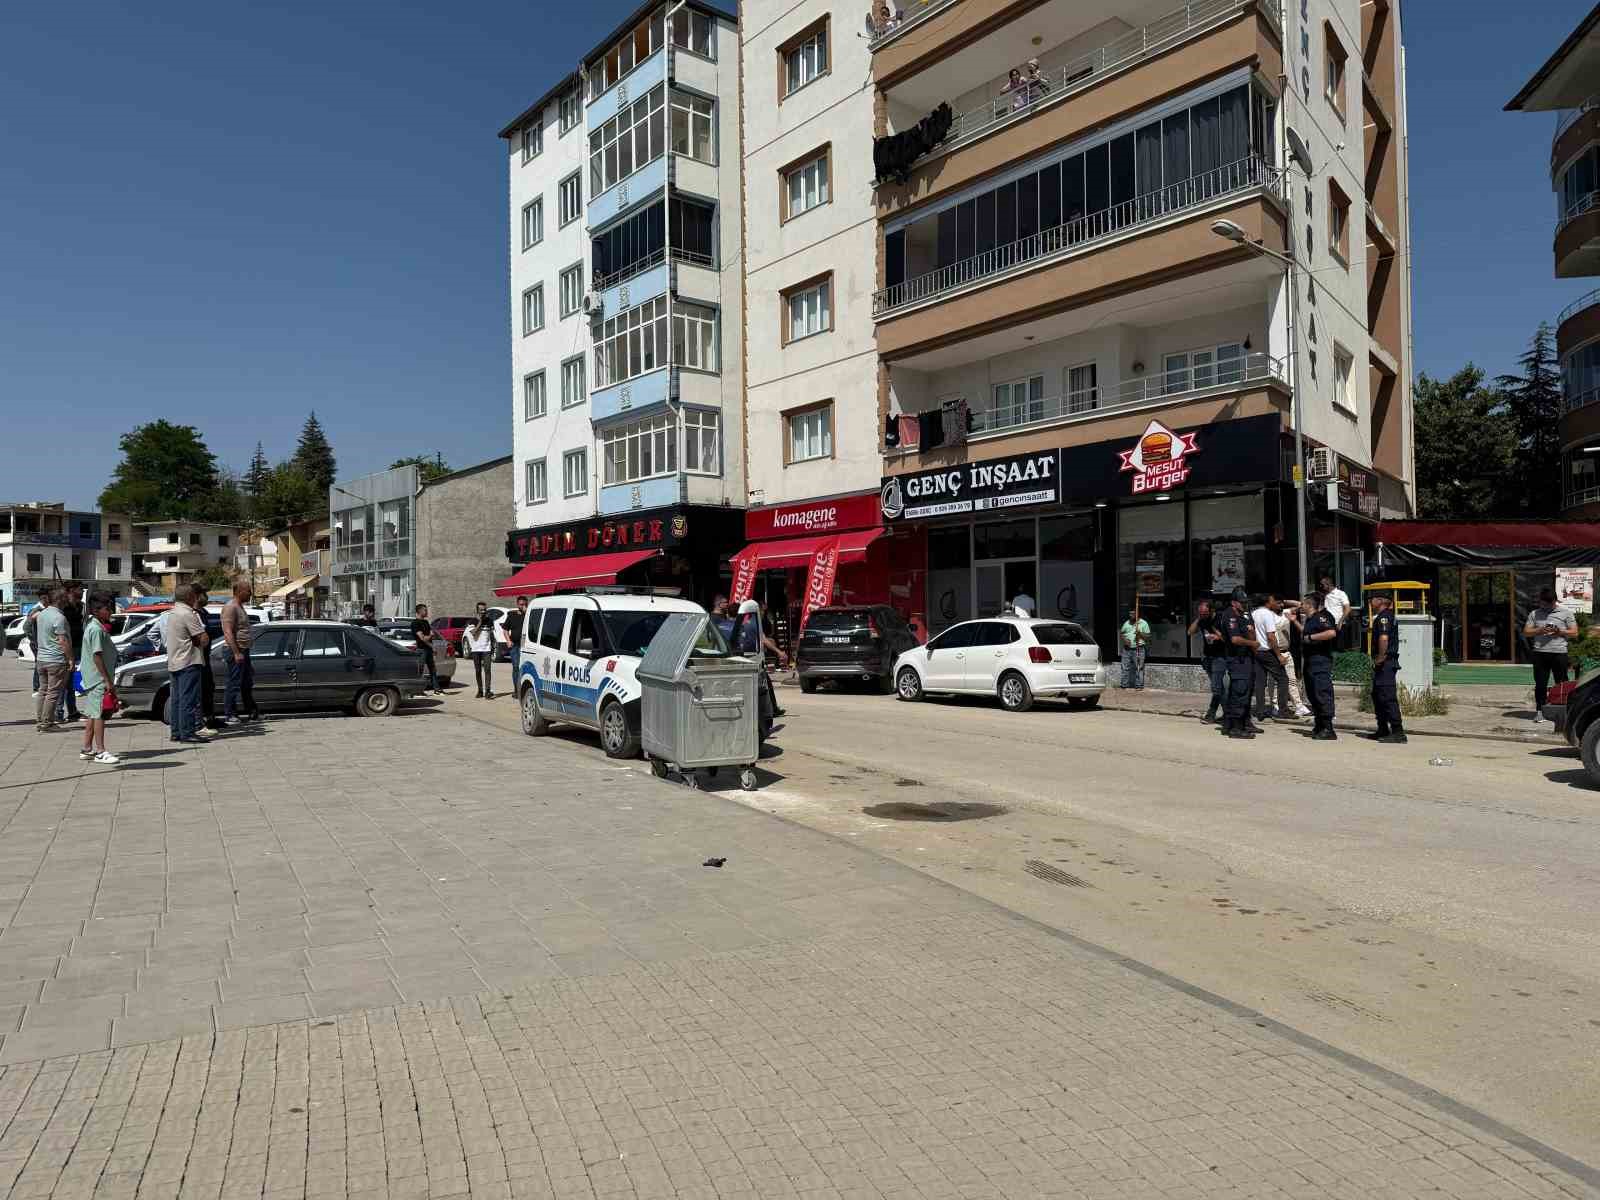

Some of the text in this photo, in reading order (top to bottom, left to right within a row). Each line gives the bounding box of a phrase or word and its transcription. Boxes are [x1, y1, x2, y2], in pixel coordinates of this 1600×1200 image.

[906, 455, 1055, 497] GENÇ İNŞAAT
[1146, 458, 1184, 477] MESUT
[1132, 469, 1189, 493] Burger
[773, 507, 837, 529] komagene
